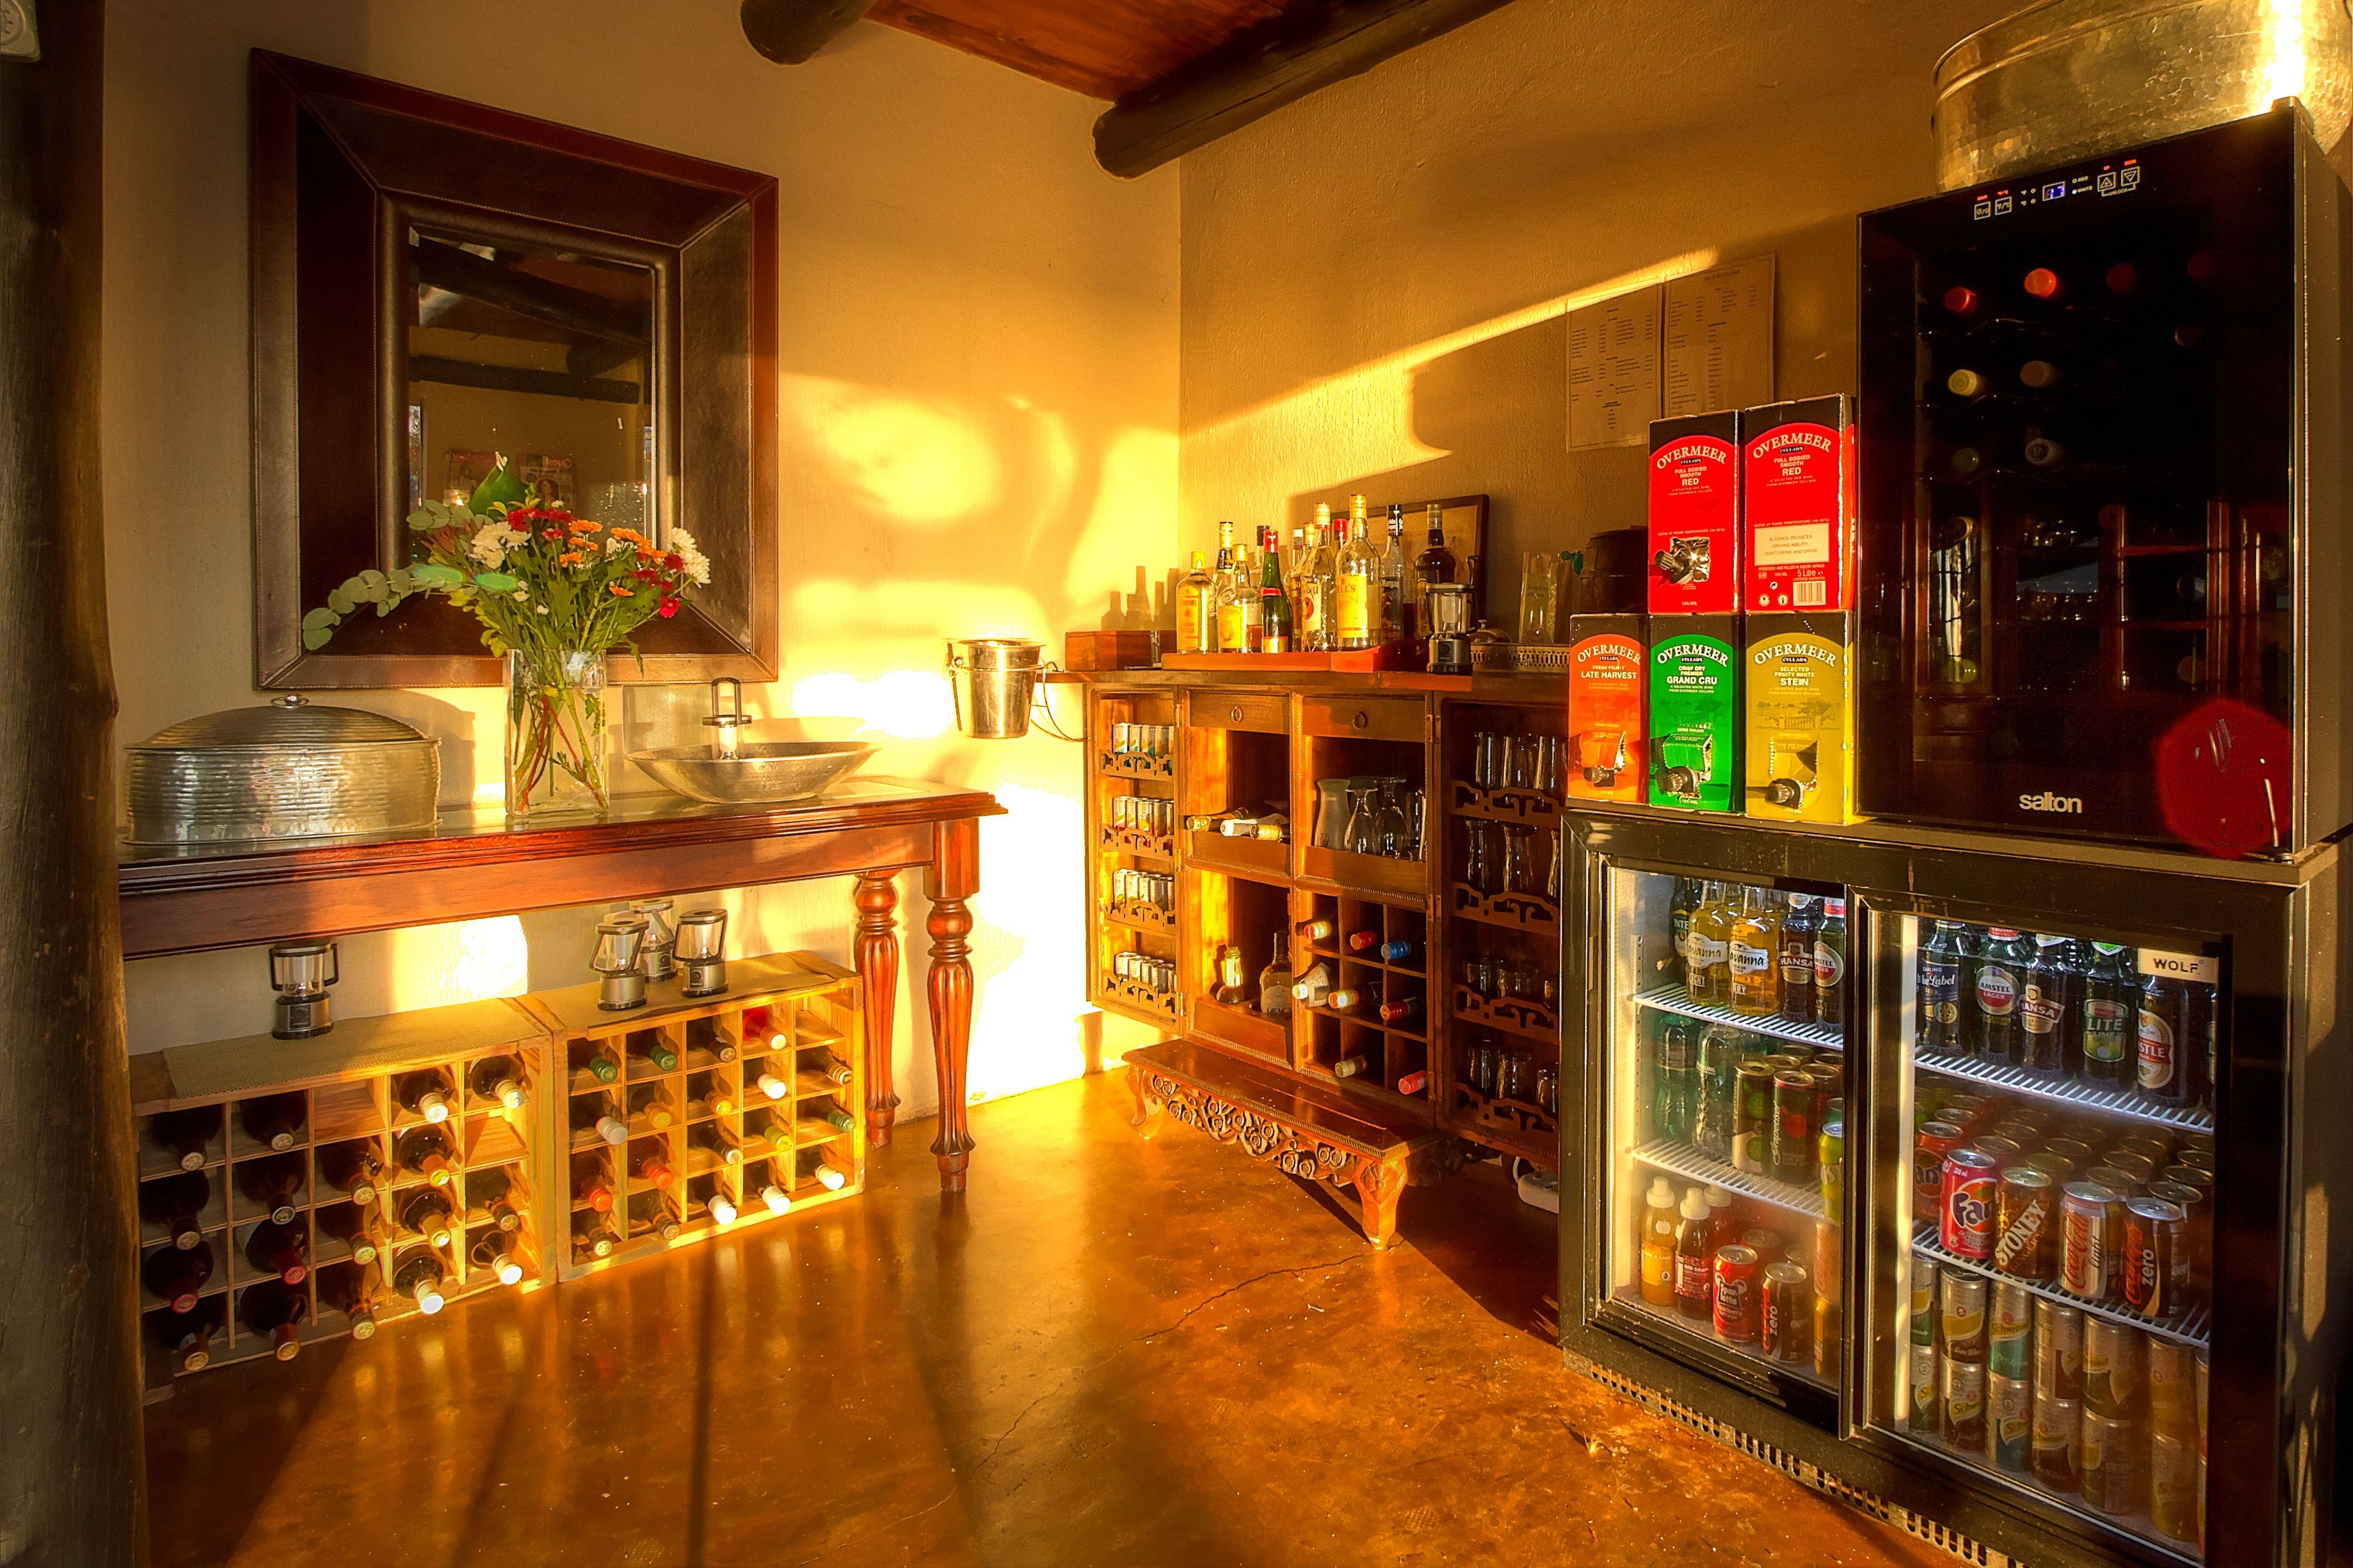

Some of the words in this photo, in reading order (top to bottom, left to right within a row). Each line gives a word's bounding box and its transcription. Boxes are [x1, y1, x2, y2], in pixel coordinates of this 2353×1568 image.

[1752, 433, 1832, 458] OVERMEER
[1656, 445, 1727, 469] OVERMEER
[1782, 467, 1802, 476] RED
[1337, 585, 1357, 594] ELL'S
[1381, 579, 1400, 589] Morgan
[1577, 644, 1641, 666] OVERMEER
[1657, 643, 1729, 667] OVERMEER
[1754, 643, 1836, 667] OVERMEER
[1666, 676, 1697, 684] GRAND
[1698, 676, 1718, 685] CRU
[1779, 677, 1809, 686] STEIN
[2019, 791, 2082, 814] salton
[1687, 944, 1722, 958] avanna
[1729, 952, 1764, 966] avanna
[1780, 958, 1813, 968] HANSA
[1814, 955, 1834, 967] MSTEL
[2153, 957, 2199, 973] WOLF
[1929, 974, 1956, 988] Label
[1980, 982, 2010, 992] AMSTEL
[2088, 1018, 2123, 1031] LITE
[2139, 1042, 2165, 1059] STLE
[1770, 1100, 1782, 1165] Grapetiser
[1951, 1191, 1992, 1227] Fan
[1995, 1199, 2047, 1266] STONEY
[2088, 1236, 2101, 1269] light
[2142, 1248, 2155, 1287] zero
[1769, 1305, 1778, 1336] zero
[1991, 1320, 2030, 1334] Schwe
